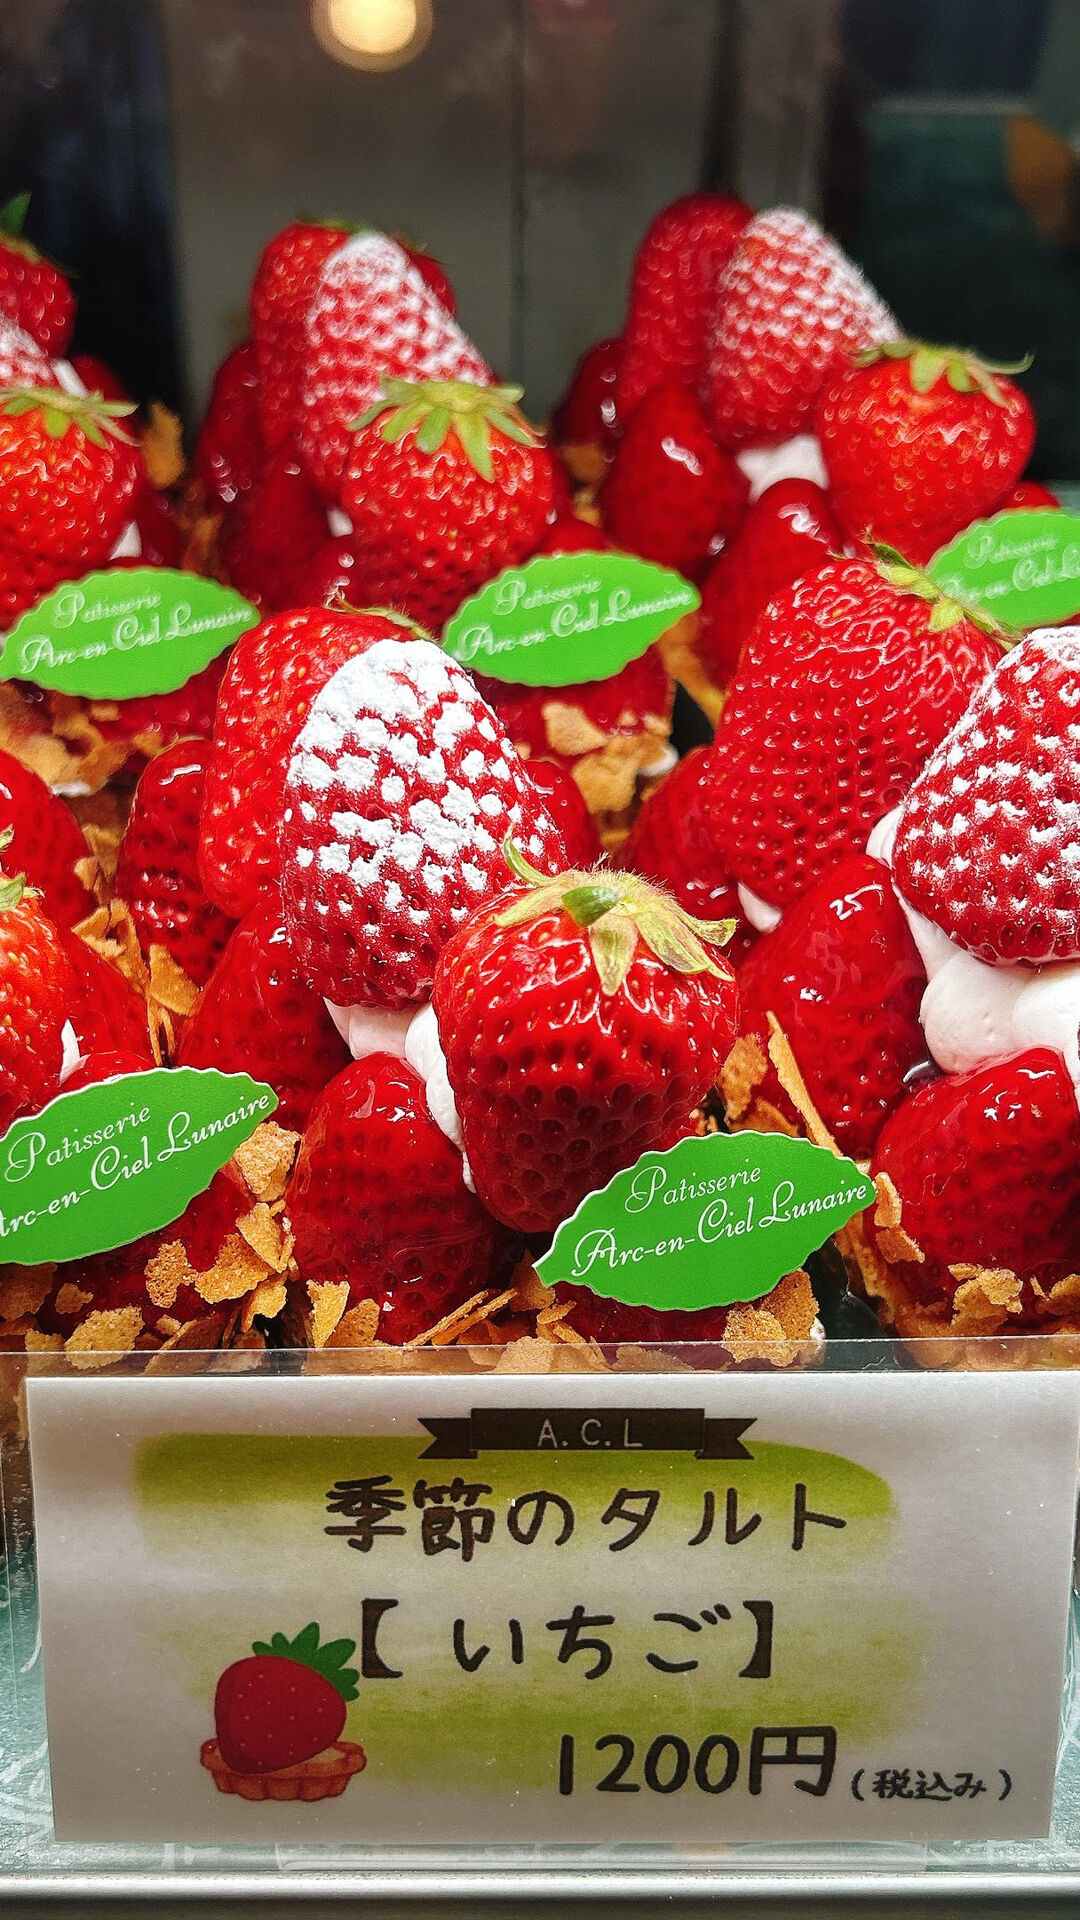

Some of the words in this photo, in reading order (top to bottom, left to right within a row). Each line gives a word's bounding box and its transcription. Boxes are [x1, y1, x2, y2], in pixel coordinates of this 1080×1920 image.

[53, 588, 162, 629] Patisserie
[492, 573, 601, 616] Patisserie
[602, 588, 693, 626] Lunaire
[19, 612, 162, 674] Arc-en-Ciel
[165, 600, 253, 641] Lunaire
[0, 1136, 153, 1237] rc-en-Ciel
[157, 1095, 270, 1162] Lunaire
[4, 1101, 151, 1183] Patisserie
[625, 1158, 761, 1213] Patisserie
[571, 1197, 754, 1277] Arc-en-Ciel
[758, 1180, 867, 1227] Lunaire
[323, 1475, 847, 1562] 季節のタルト
[362, 1598, 774, 1679] 【いちご】
[559, 1725, 837, 1796] 1200円
